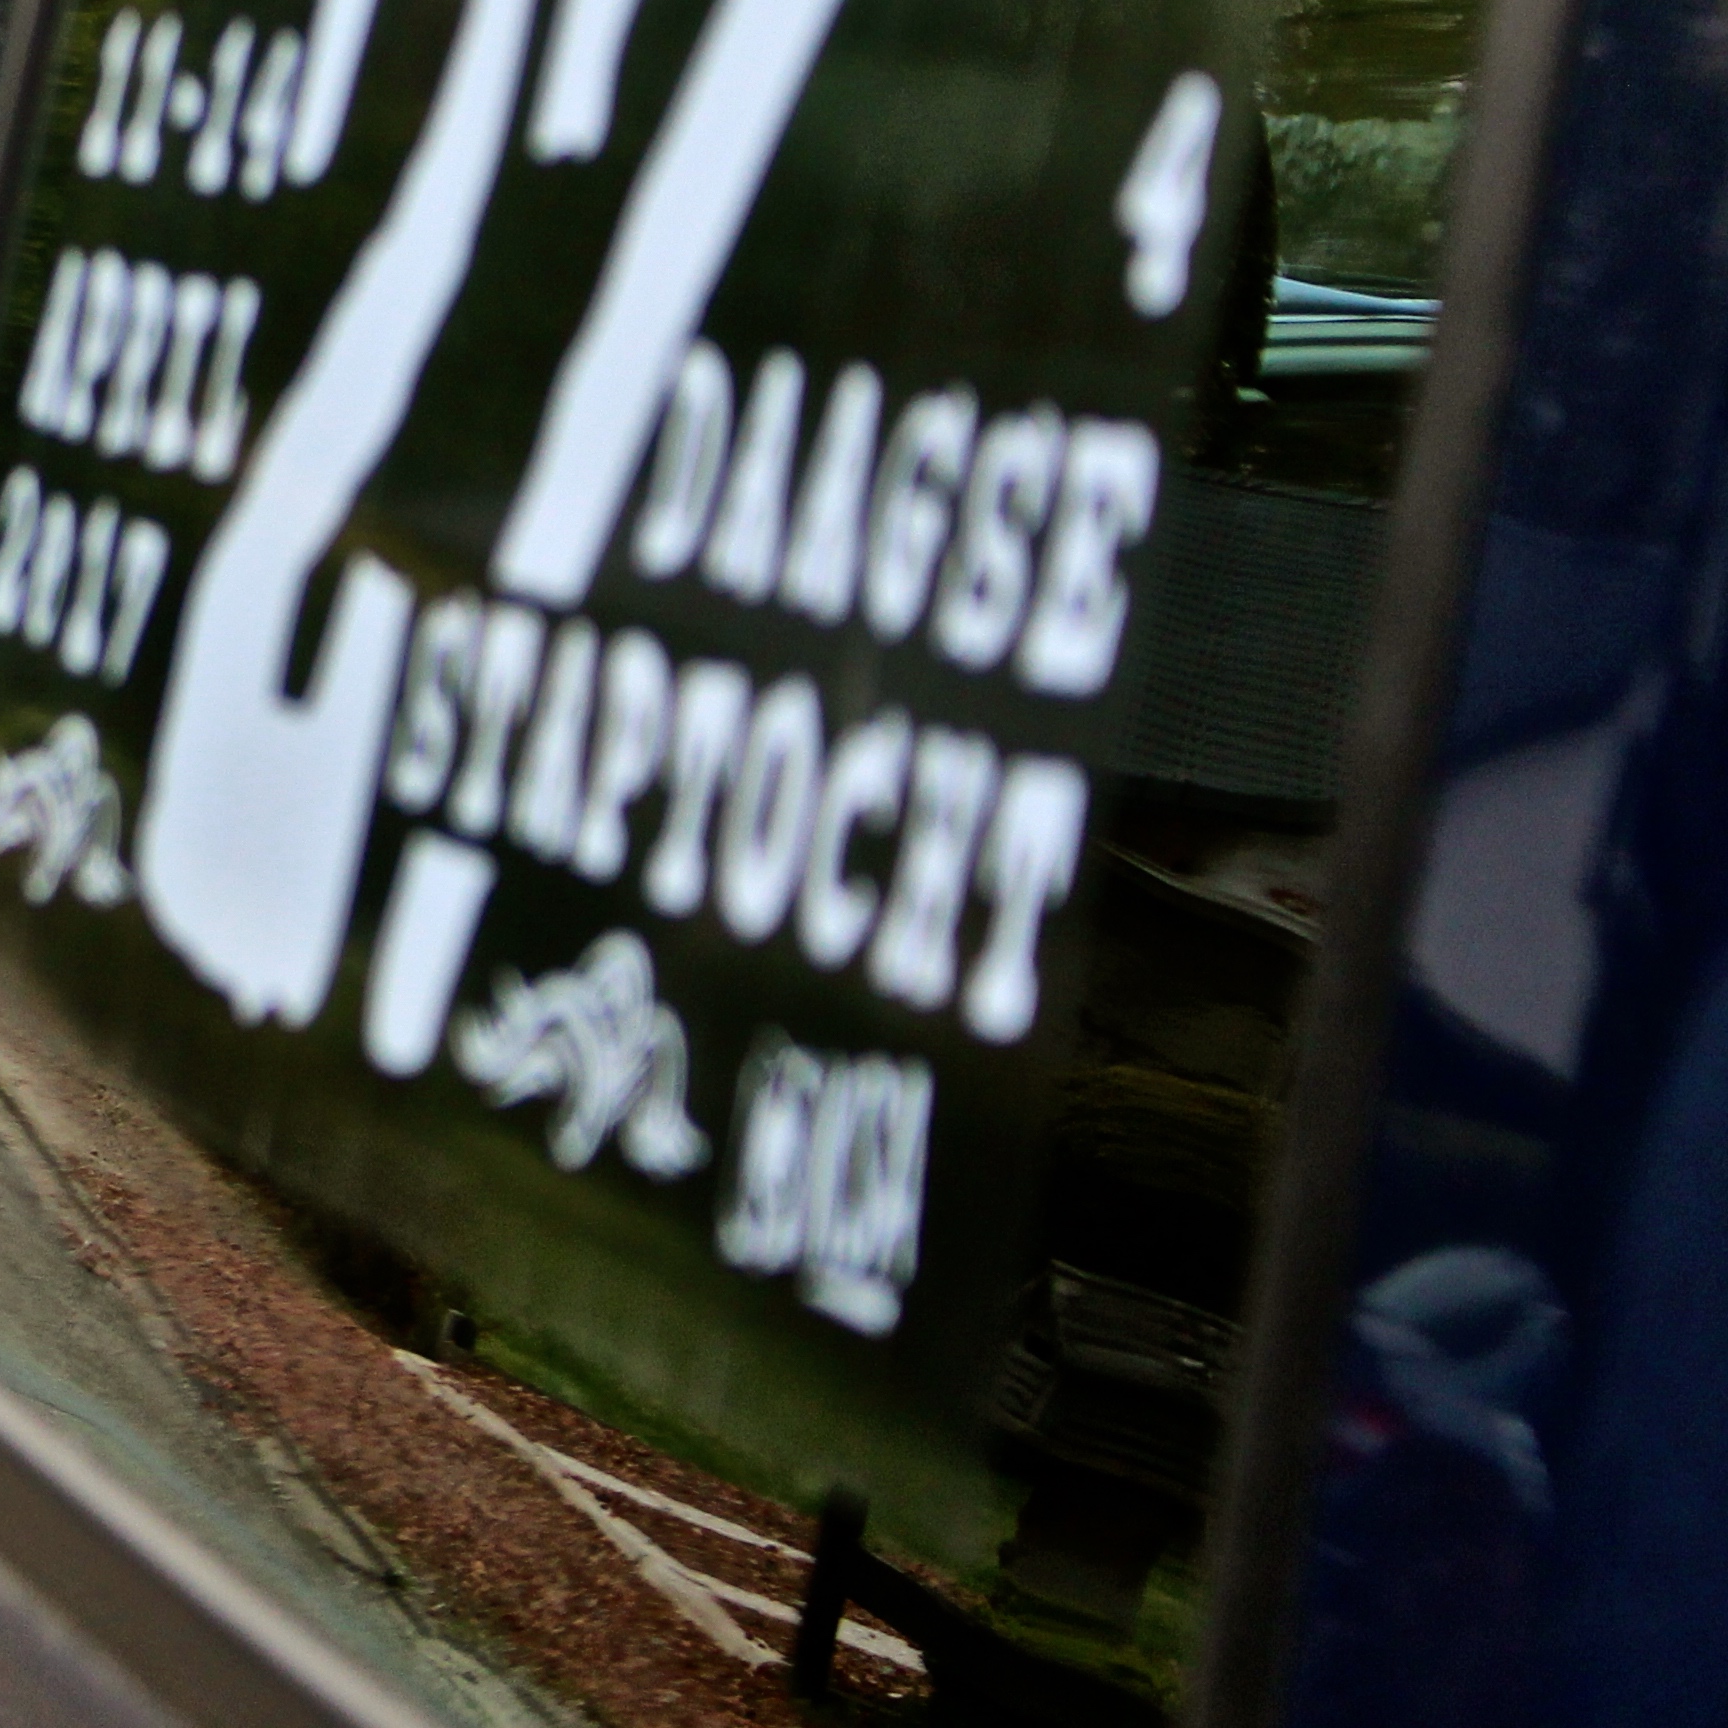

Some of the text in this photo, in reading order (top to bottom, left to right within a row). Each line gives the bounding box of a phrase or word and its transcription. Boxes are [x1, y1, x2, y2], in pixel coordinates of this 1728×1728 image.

[1115, 70, 1224, 318] 4
[24, 246, 264, 484] APRIL
[632, 336, 1161, 698] DAAGSE
[386, 588, 1090, 1044] STAPTOCHT
